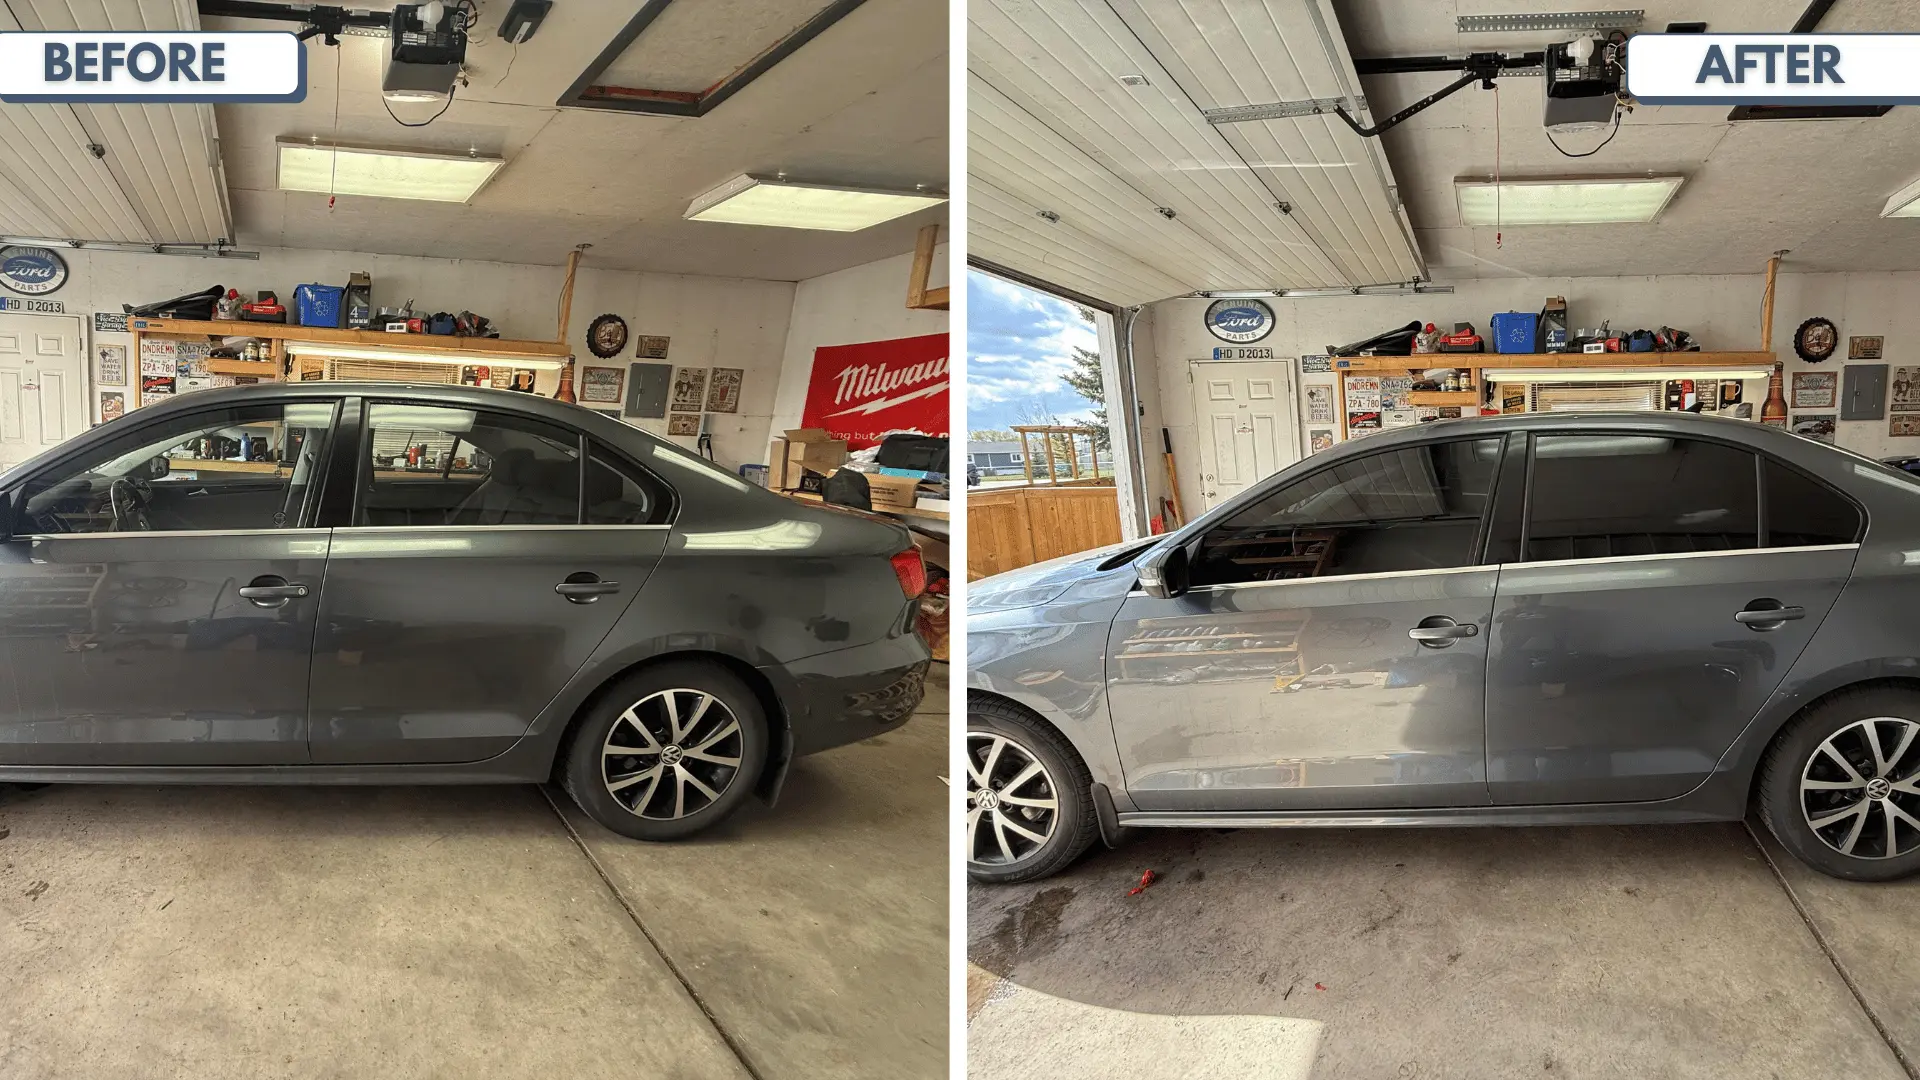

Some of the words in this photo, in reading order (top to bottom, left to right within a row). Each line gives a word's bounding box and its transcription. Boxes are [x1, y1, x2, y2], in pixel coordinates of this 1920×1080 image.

[14, 282, 48, 291] PARTS
[6, 299, 20, 310] HD
[350, 305, 359, 318] 4
[1218, 310, 1260, 327] Ford
[1226, 332, 1257, 340] PARTS
[1547, 330, 1556, 342] 4
[1220, 349, 1232, 358] HD
[854, 431, 876, 440] but
